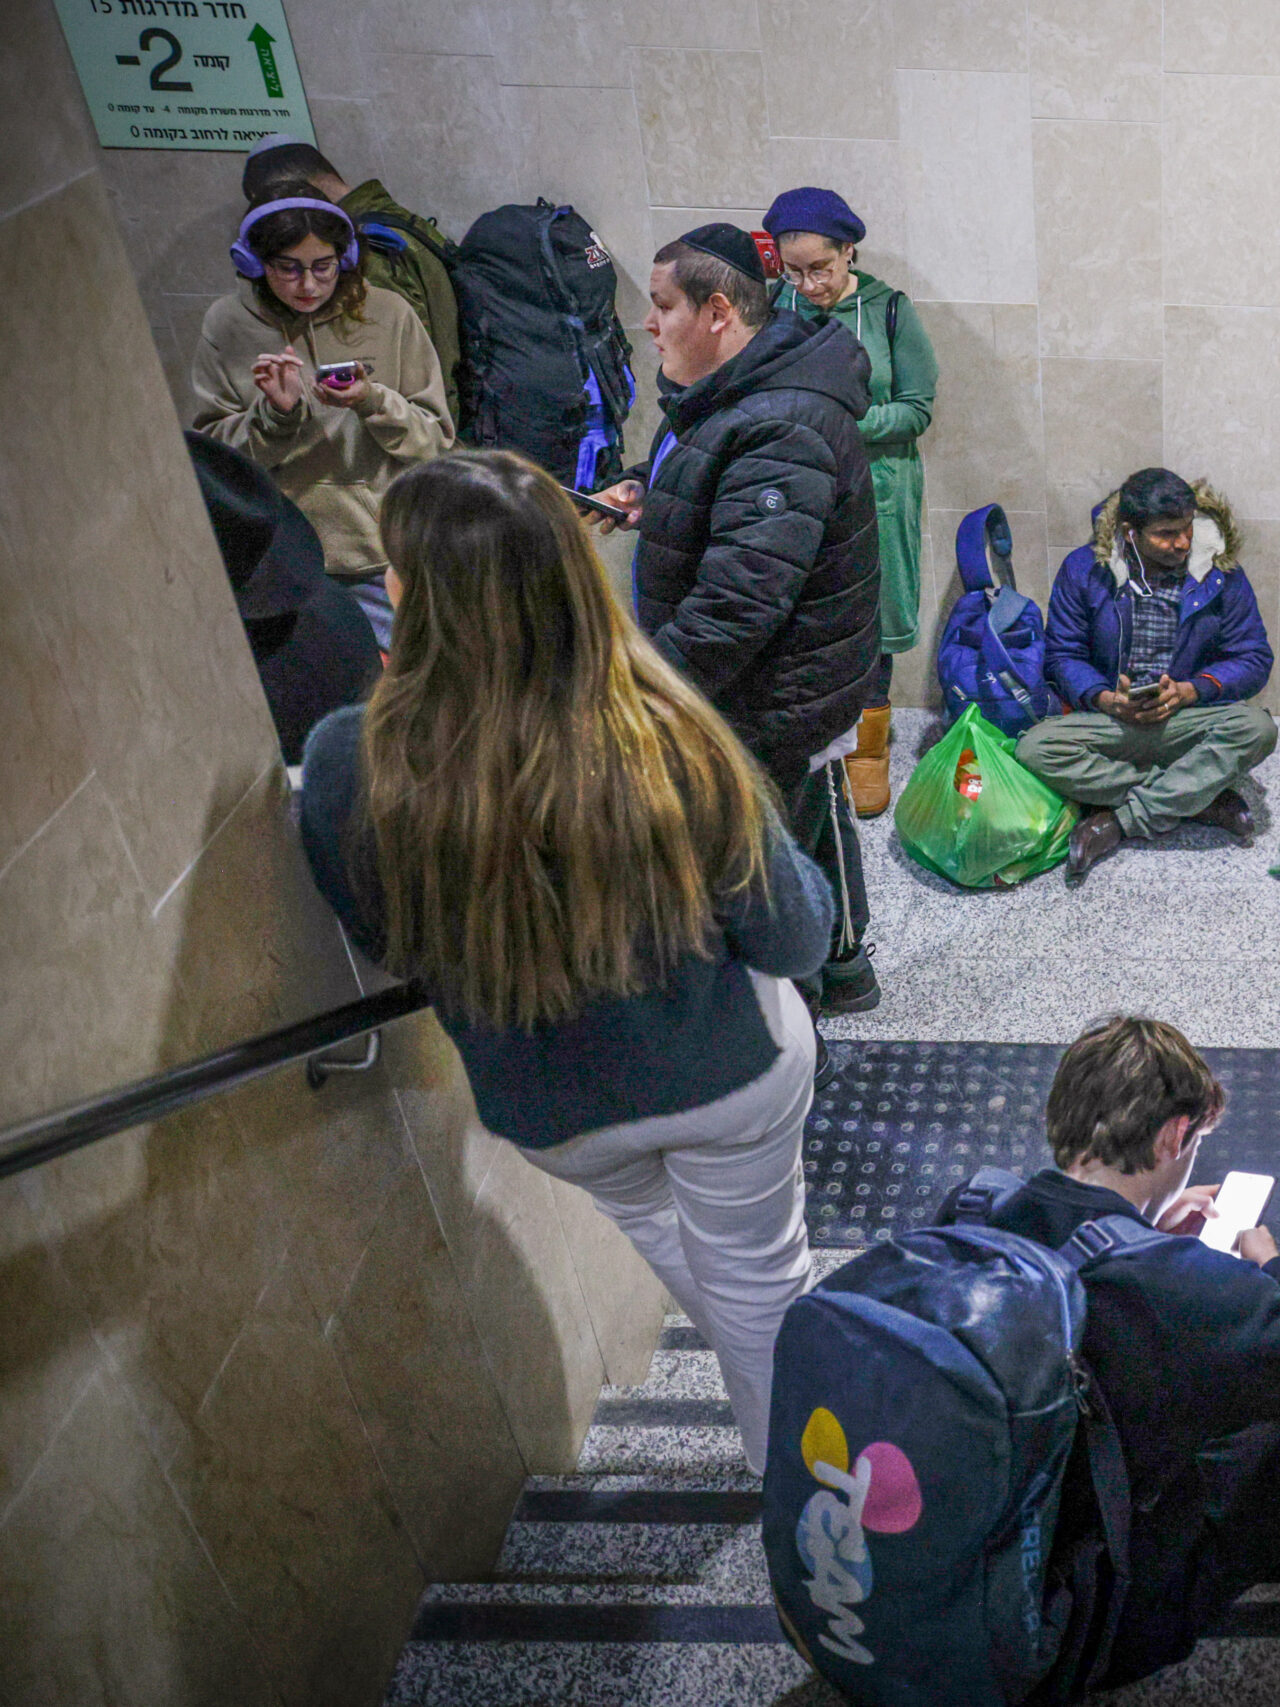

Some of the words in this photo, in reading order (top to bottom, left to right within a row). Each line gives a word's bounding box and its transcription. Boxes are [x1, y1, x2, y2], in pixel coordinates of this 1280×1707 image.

[121, 0, 199, 18] מדרגות
[207, 2, 248, 19] חדר
[115, 27, 194, 92] -2
[193, 54, 230, 71] קומה
[108, 103, 115, 112] 0
[117, 104, 141, 114] קומה
[143, 105, 155, 113] עד
[239, 108, 271, 117] מדרגות
[275, 109, 290, 117] חדר
[130, 125, 140, 138] 0
[142, 127, 188, 141] בקומה
[190, 127, 230, 140] לרחוב
[232, 130, 279, 141] יציאה
